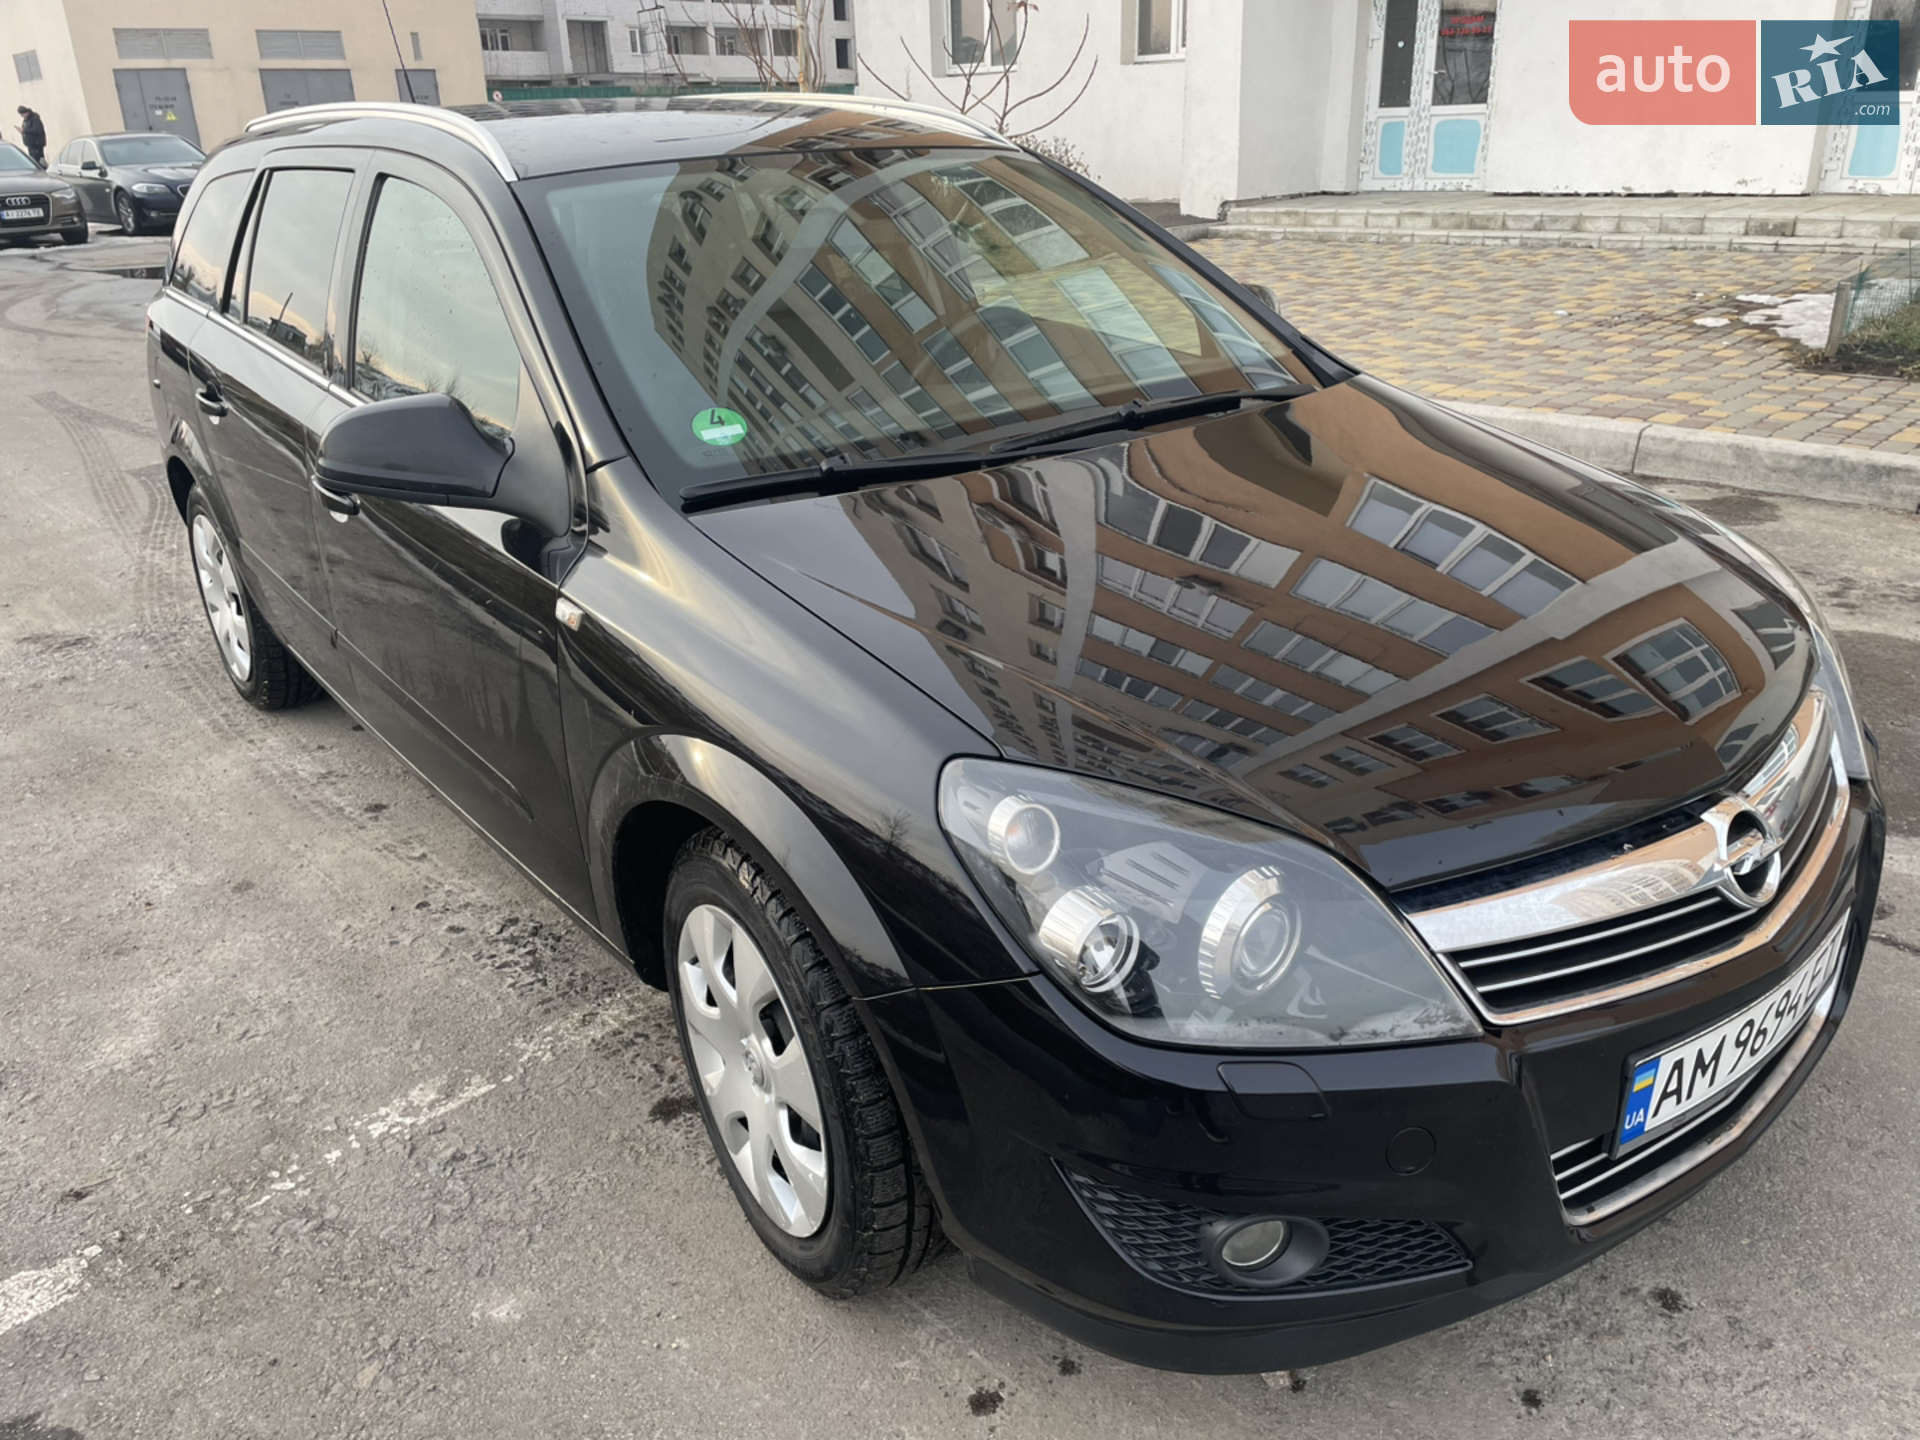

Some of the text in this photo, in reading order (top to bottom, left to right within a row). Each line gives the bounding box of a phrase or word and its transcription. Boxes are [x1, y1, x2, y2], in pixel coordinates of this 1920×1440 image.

[709, 409, 726, 426] 4
[1650, 1033, 1728, 1119] AM
[1726, 970, 1810, 1077] 9694
[1624, 1107, 1645, 1131] UA
